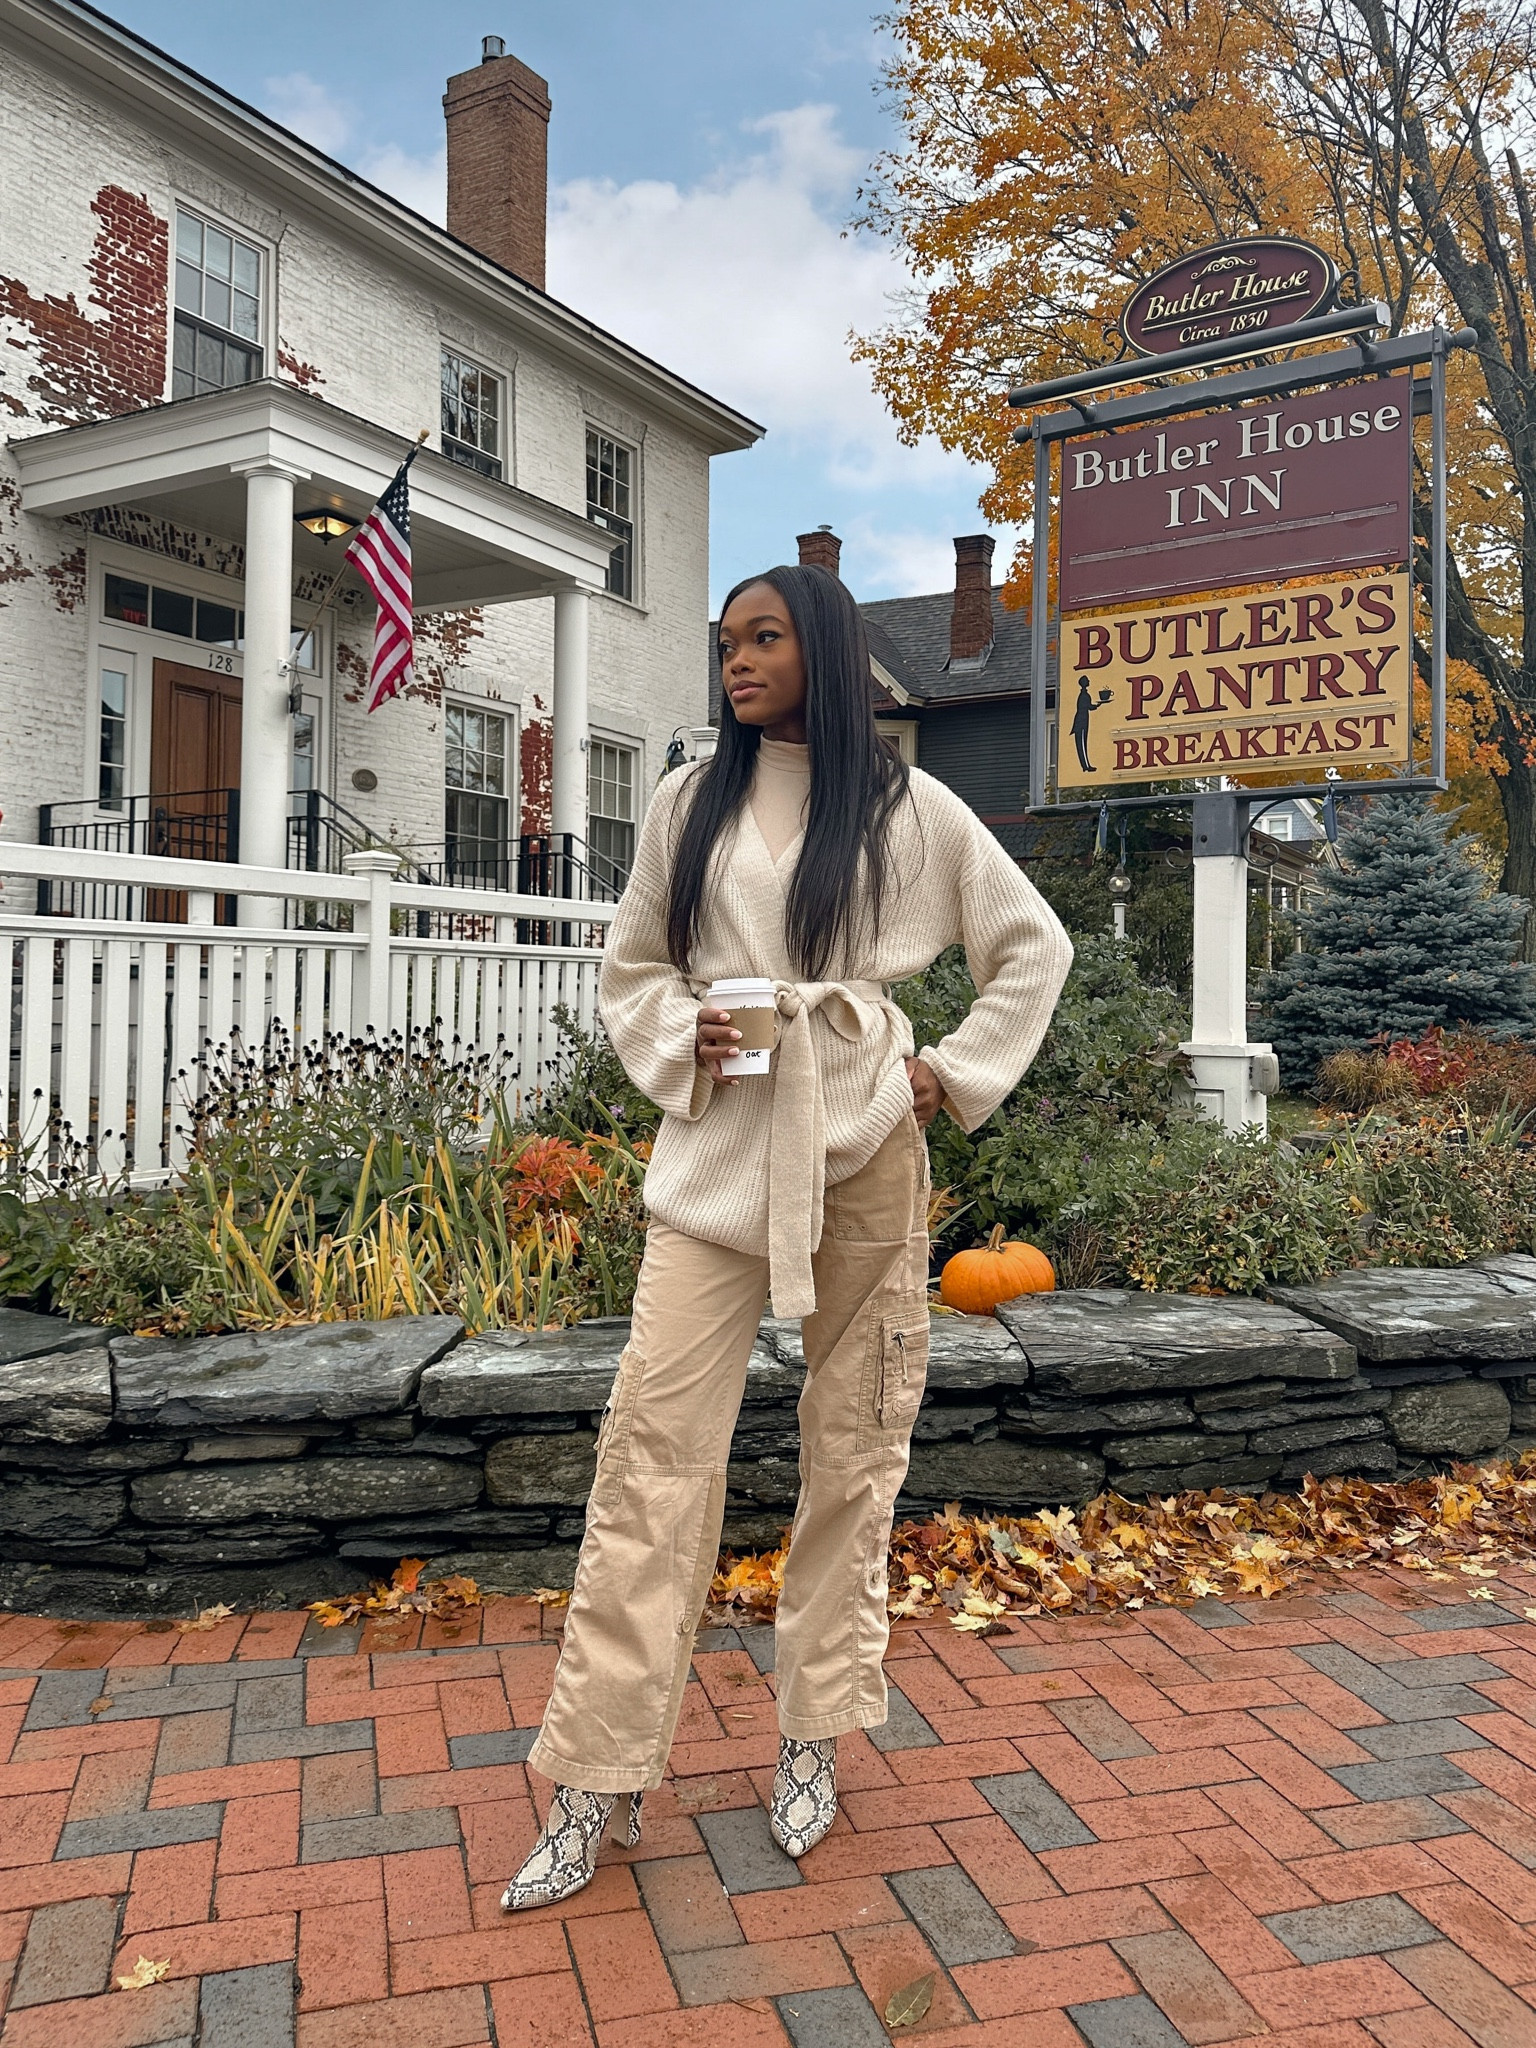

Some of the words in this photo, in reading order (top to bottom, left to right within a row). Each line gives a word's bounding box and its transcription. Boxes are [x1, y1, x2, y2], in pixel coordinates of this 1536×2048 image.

[1143, 284, 1225, 322] Butler
[1228, 269, 1309, 302] House
[1179, 325, 1221, 343] Circa
[1228, 309, 1269, 333] 1830
[1070, 432, 1219, 491] Butler
[1235, 404, 1401, 459] House
[1164, 468, 1288, 529] INN
[1073, 584, 1397, 671] BUTLER'S
[208, 653, 233, 673] 128
[1125, 645, 1400, 721] PANTRY
[1112, 713, 1396, 771] BREAKFAST
